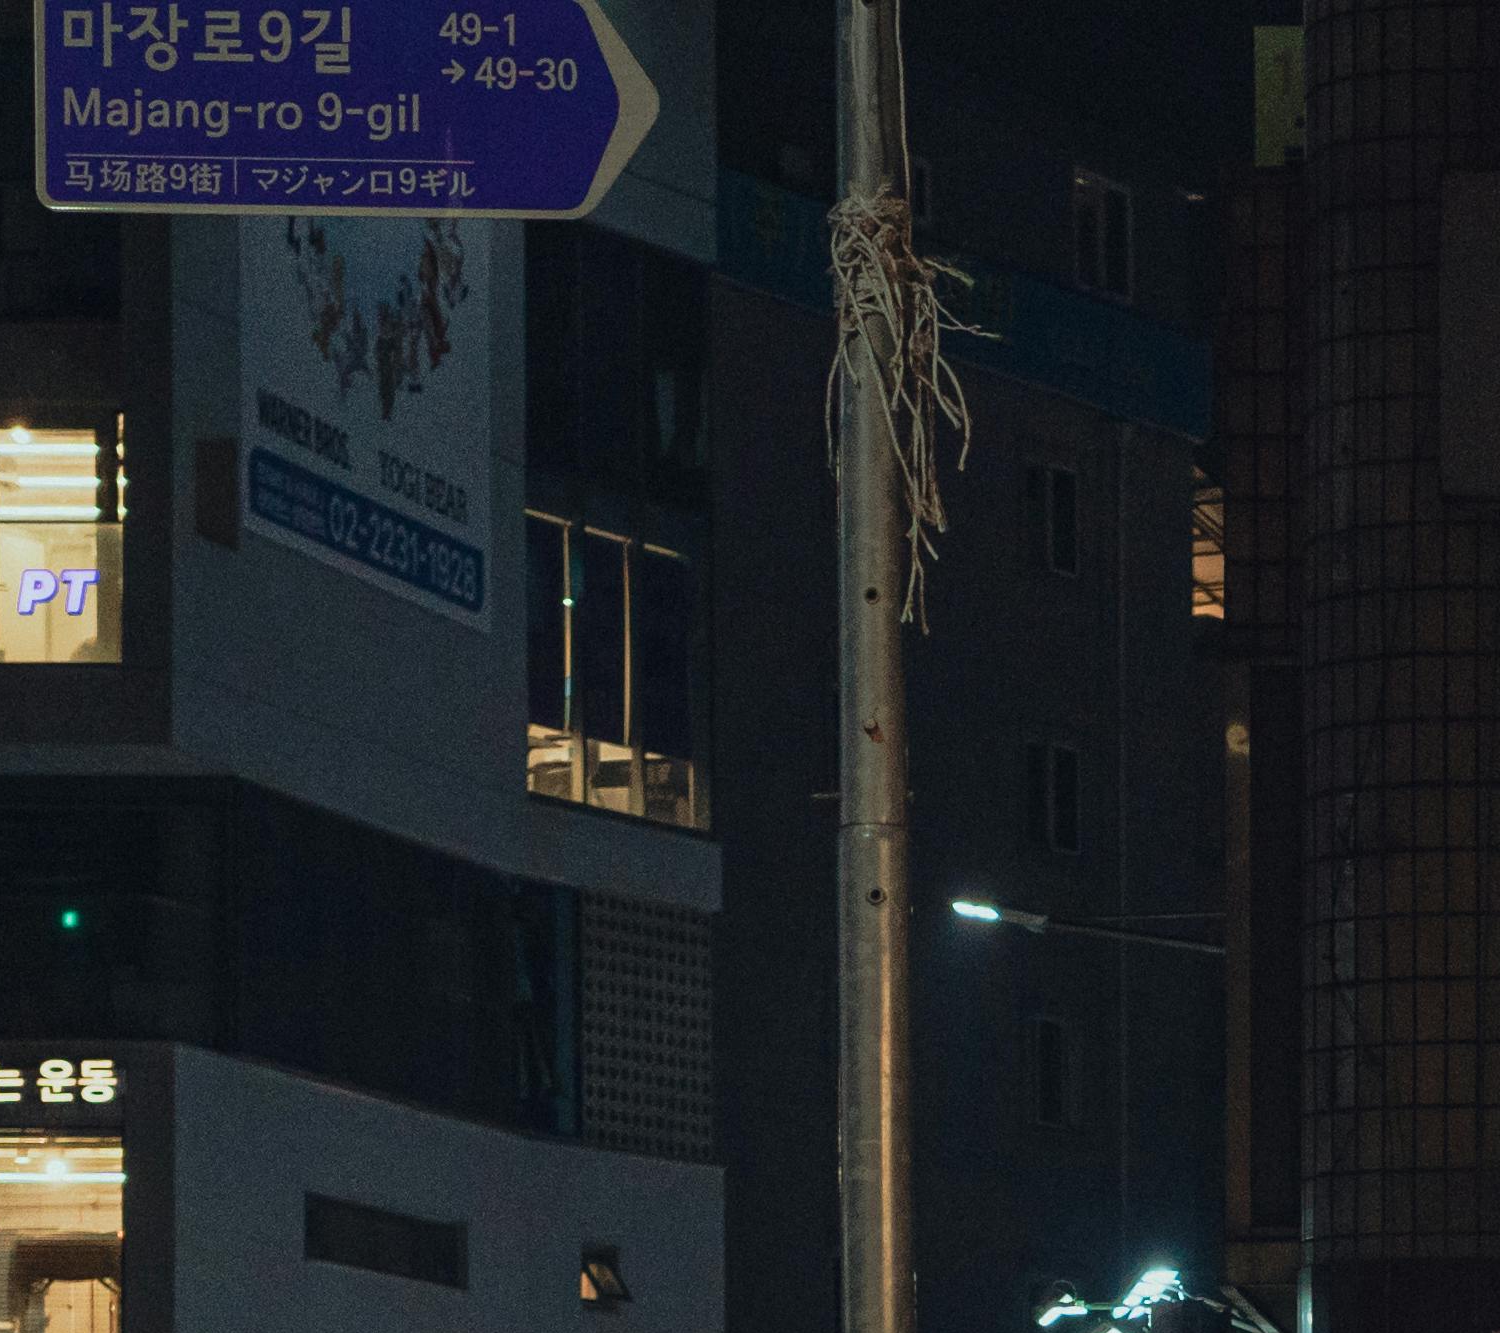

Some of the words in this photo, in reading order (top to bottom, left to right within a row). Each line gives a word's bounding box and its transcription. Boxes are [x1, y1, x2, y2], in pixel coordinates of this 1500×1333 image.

[62, 4, 353, 74] 마장로9길
[439, 13, 517, 46] 49-1
[474, 58, 578, 91] 49-30
[63, 88, 302, 138] Majang-ro
[317, 93, 420, 141] 9-gil
[64, 160, 221, 196] 马场路9街
[251, 166, 476, 198] マジャンロ9ギル
[18, 568, 100, 616] PT
[36, 1059, 118, 1103] 운동
